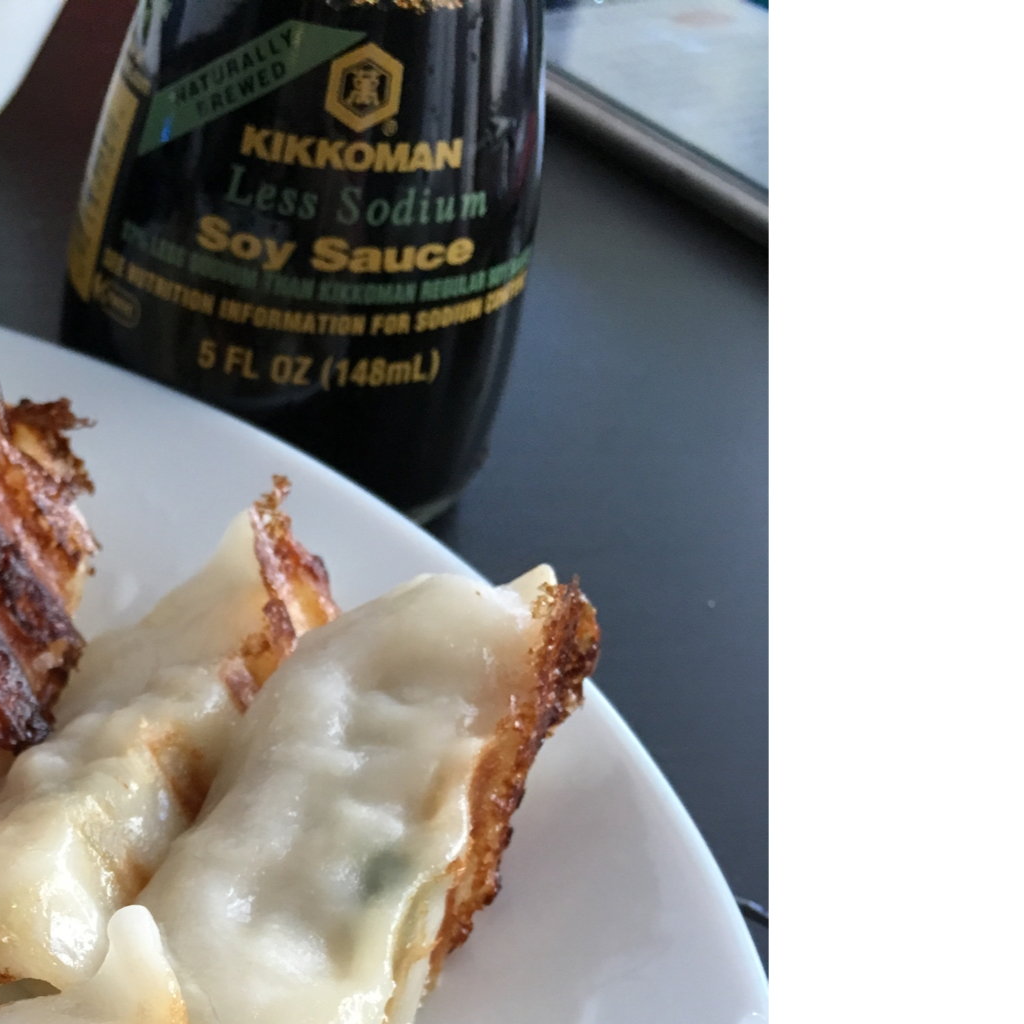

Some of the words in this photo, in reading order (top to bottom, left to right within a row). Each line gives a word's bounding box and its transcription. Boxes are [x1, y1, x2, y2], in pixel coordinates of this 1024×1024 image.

[176, 28, 293, 101] NATURALLY
[240, 124, 464, 173] KIKKOMAN
[226, 163, 317, 220] Less
[337, 186, 487, 226] Sodium
[196, 214, 297, 271] Soy
[310, 236, 474, 273] Sauce
[219, 298, 367, 337] INFORMATION
[370, 311, 411, 336] FOR
[414, 297, 484, 333] SODIUM
[197, 339, 216, 369] 5
[224, 345, 259, 380] FL
[270, 354, 313, 386] OZ
[321, 347, 441, 391] (148mL)
